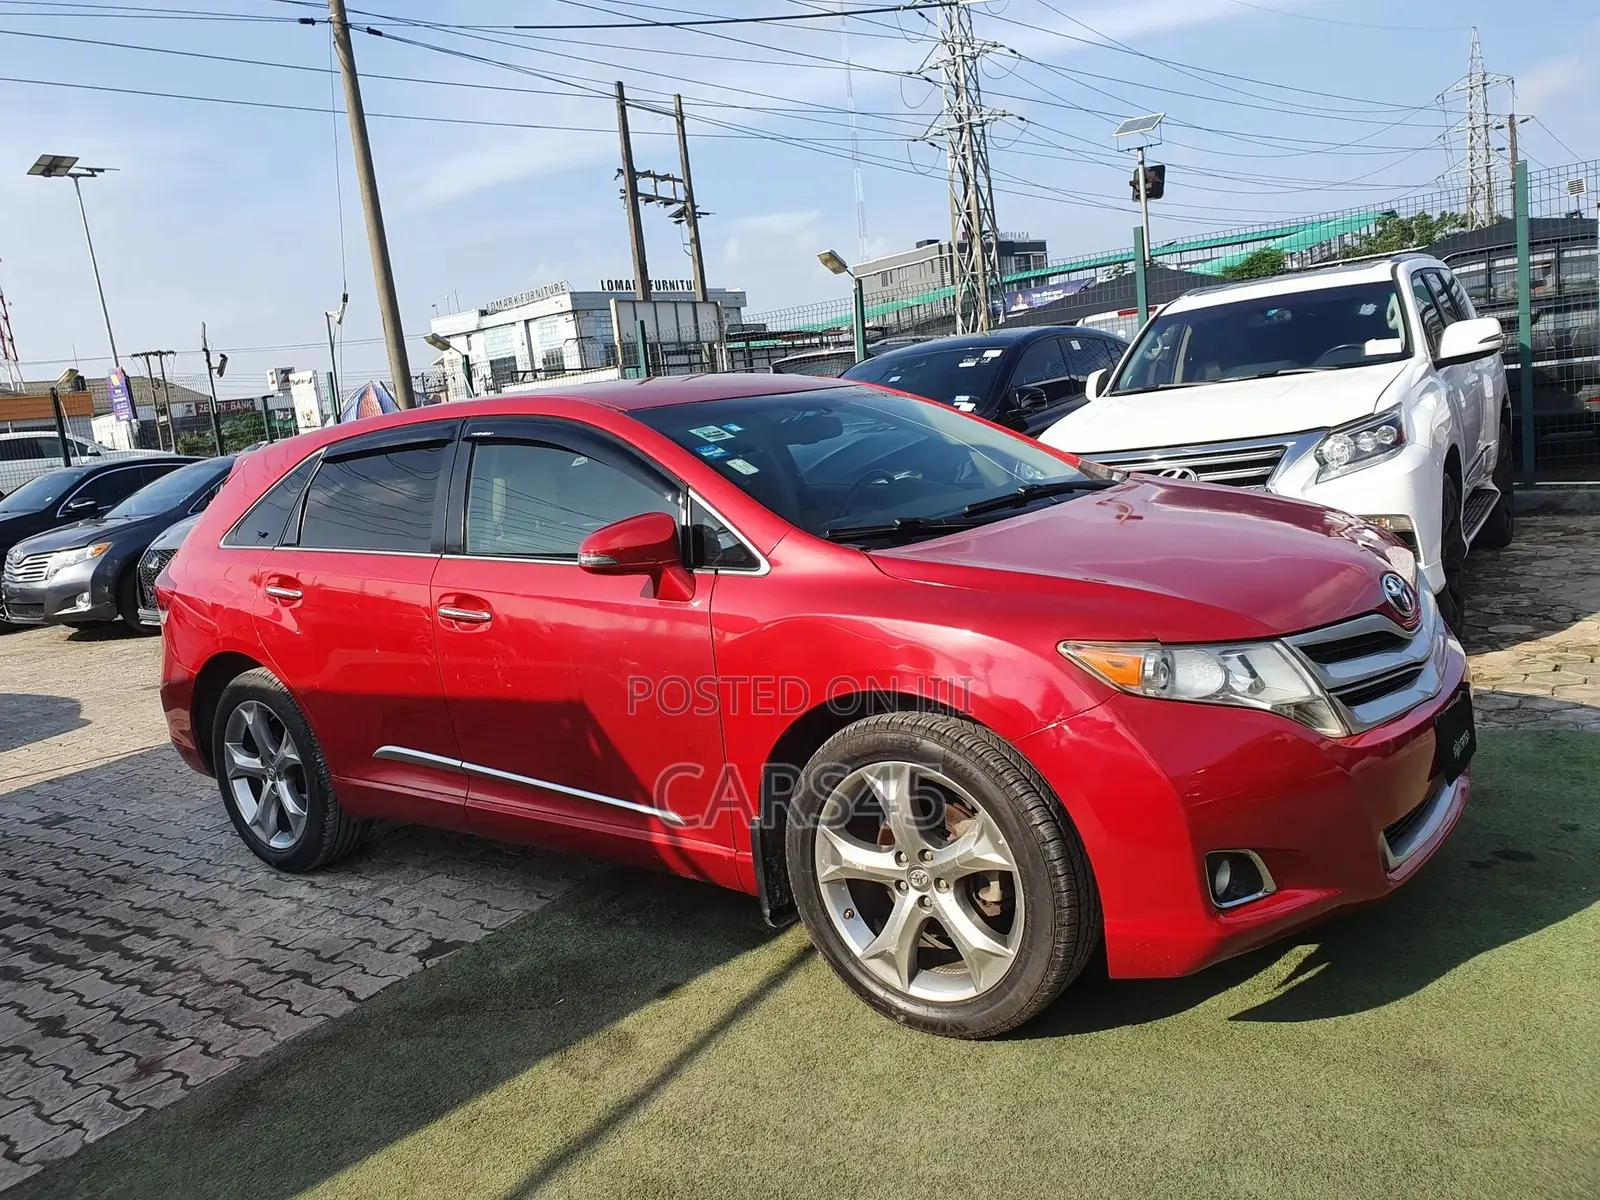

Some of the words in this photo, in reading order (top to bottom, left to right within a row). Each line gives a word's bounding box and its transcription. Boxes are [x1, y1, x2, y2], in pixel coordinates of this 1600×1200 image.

[650, 279, 697, 291] FURNITU
[486, 294, 519, 311] LOMARK
[520, 281, 566, 301] FURNITURE
[199, 402, 226, 413] ZETH
[230, 400, 253, 411] BANK
